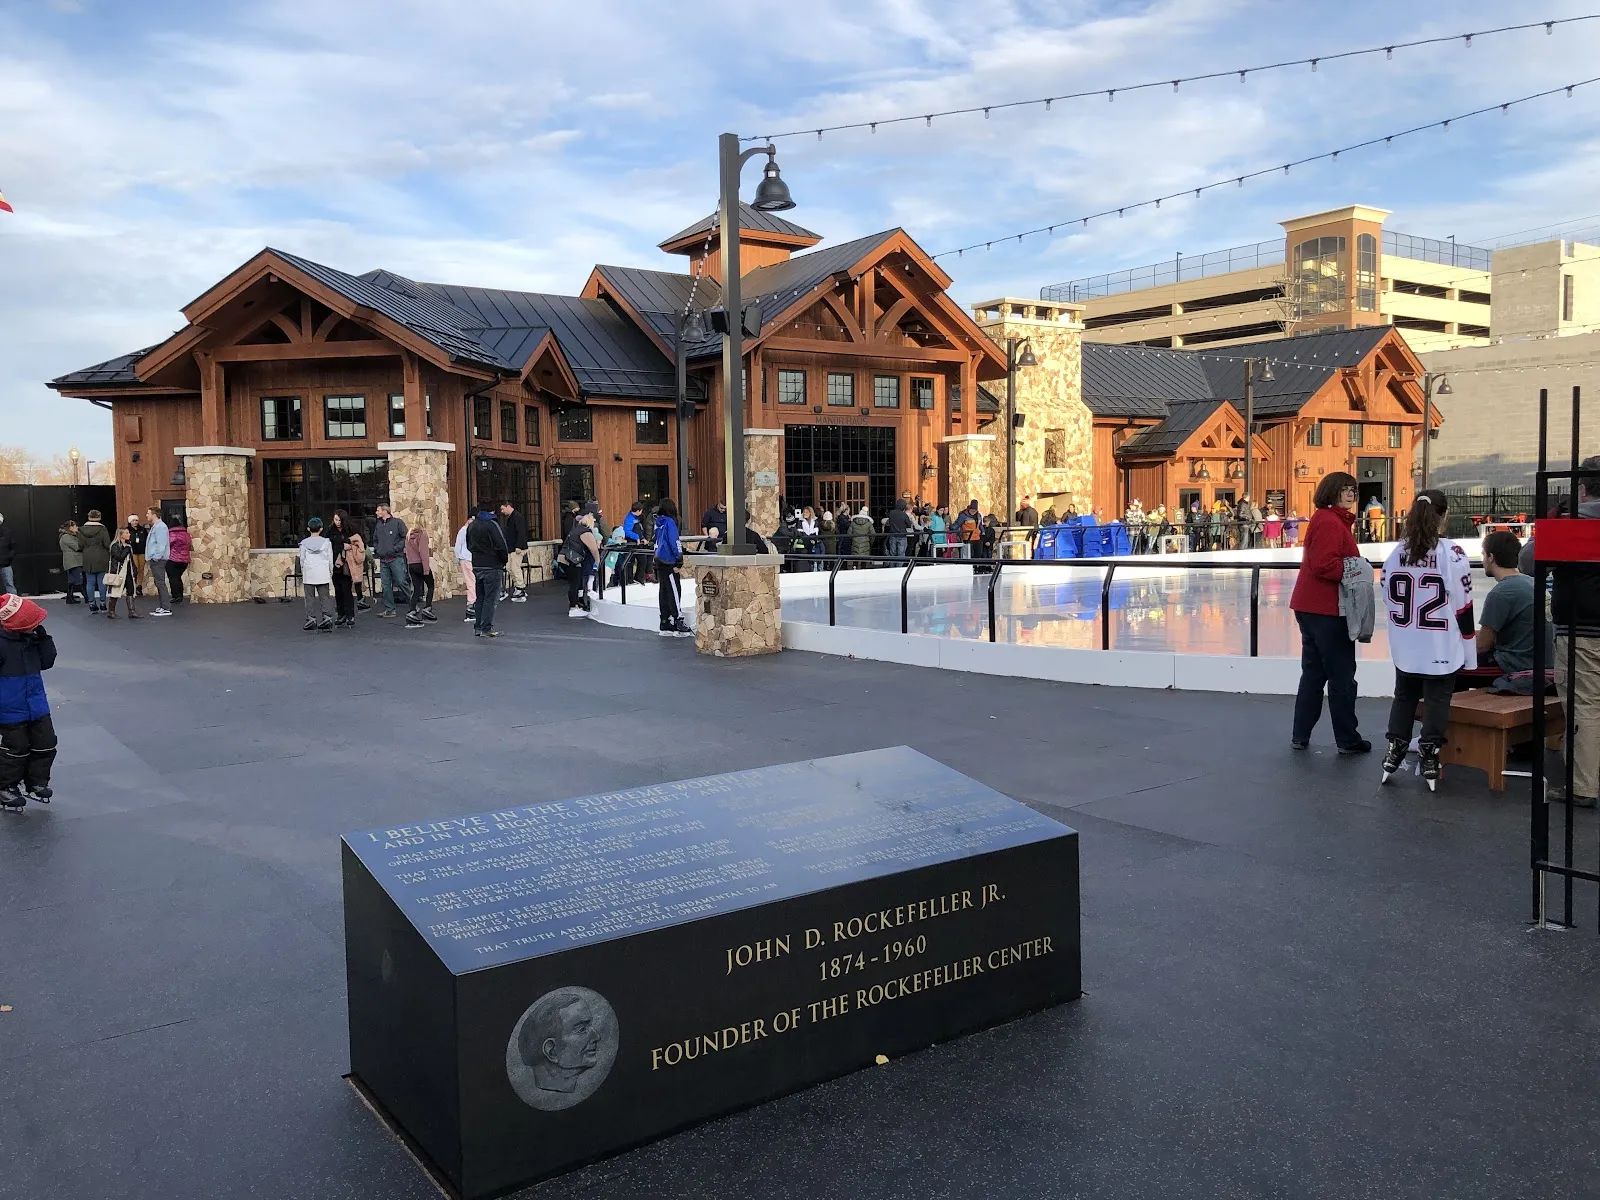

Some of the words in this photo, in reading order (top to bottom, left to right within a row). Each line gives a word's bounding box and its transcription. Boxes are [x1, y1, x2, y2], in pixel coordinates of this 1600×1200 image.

[815, 416, 844, 425] MANOR
[846, 416, 868, 426] HAUS
[1399, 553, 1437, 568] WLSH
[1388, 571, 1448, 631] 92
[381, 836, 426, 849] AND
[430, 832, 454, 840] IN
[458, 826, 491, 836] HIS
[494, 815, 552, 829] RIGHT
[554, 810, 582, 819] TO
[626, 792, 695, 807] LIBERTY
[695, 785, 732, 795] AND
[385, 816, 485, 838] BELIEVE
[490, 811, 518, 821] IN
[522, 803, 569, 816] THE
[574, 787, 666, 807] SUPREME
[670, 775, 738, 791] WORTH
[394, 851, 425, 860] THAT
[428, 844, 466, 854] EVERY
[469, 837, 503, 847] RIGHT
[506, 830, 549, 840] IMPLIES
[519, 822, 564, 833] BELIEVE
[535, 837, 582, 848] BELIEVE
[556, 828, 590, 836] EVERY
[396, 870, 426, 879] THAT
[430, 865, 453, 873] THE
[456, 860, 481, 868] LAW
[509, 850, 540, 858] MADE
[434, 869, 465, 878] THAT
[468, 854, 546, 872] GOVERNMENT
[586, 838, 632, 849] SERVANT
[504, 863, 529, 871] AND
[558, 852, 590, 860] THEIR
[559, 857, 606, 869] BELIEVE
[430, 897, 463, 906] THAT
[466, 891, 489, 899] THE
[493, 883, 534, 894] WORLD
[537, 876, 567, 885] OWES
[588, 867, 615, 875] MAN
[627, 857, 665, 867] LIVING
[433, 891, 457, 899] THE
[460, 881, 510, 894] DIGNITY
[573, 859, 624, 872] WHETHER
[436, 902, 469, 912] OWES
[472, 894, 511, 905] EVERY
[514, 887, 542, 896] MAN
[564, 868, 639, 886] OPPORTUNITY
[583, 879, 632, 892] BELIEVE
[429, 920, 461, 931] THAT
[464, 911, 506, 923] THRIFT
[522, 896, 580, 911] ESSENTIAL
[601, 885, 629, 894] WELL
[631, 875, 678, 888] ORDERED
[433, 921, 488, 937] ECONOMY
[515, 909, 549, 919] PRIME
[551, 897, 605, 912] REQUISITE
[631, 884, 665, 895] SOUND
[453, 924, 510, 940] WHETHER
[529, 903, 608, 923] GOVERNMENT
[610, 892, 659, 906] BUSINESS
[609, 902, 660, 916] BELIEVE
[475, 942, 510, 953] THAT
[513, 932, 555, 945] TRUTH
[558, 925, 586, 935] AND
[588, 914, 635, 928] JUSTICE
[637, 908, 662, 917] ARE
[570, 922, 632, 940] ENDURING
[634, 912, 676, 925] SOCIAL
[726, 933, 791, 976] JOHN
[804, 928, 826, 950] D.
[832, 890, 973, 942] ROCKEFELLER
[980, 883, 1007, 910] JR.
[651, 1019, 768, 1070] FOUNDER
[773, 1007, 801, 1034] OF
[807, 993, 849, 1023] THE
[856, 954, 984, 1009] ROCKEFELLER
[987, 936, 1054, 970] CENTER
